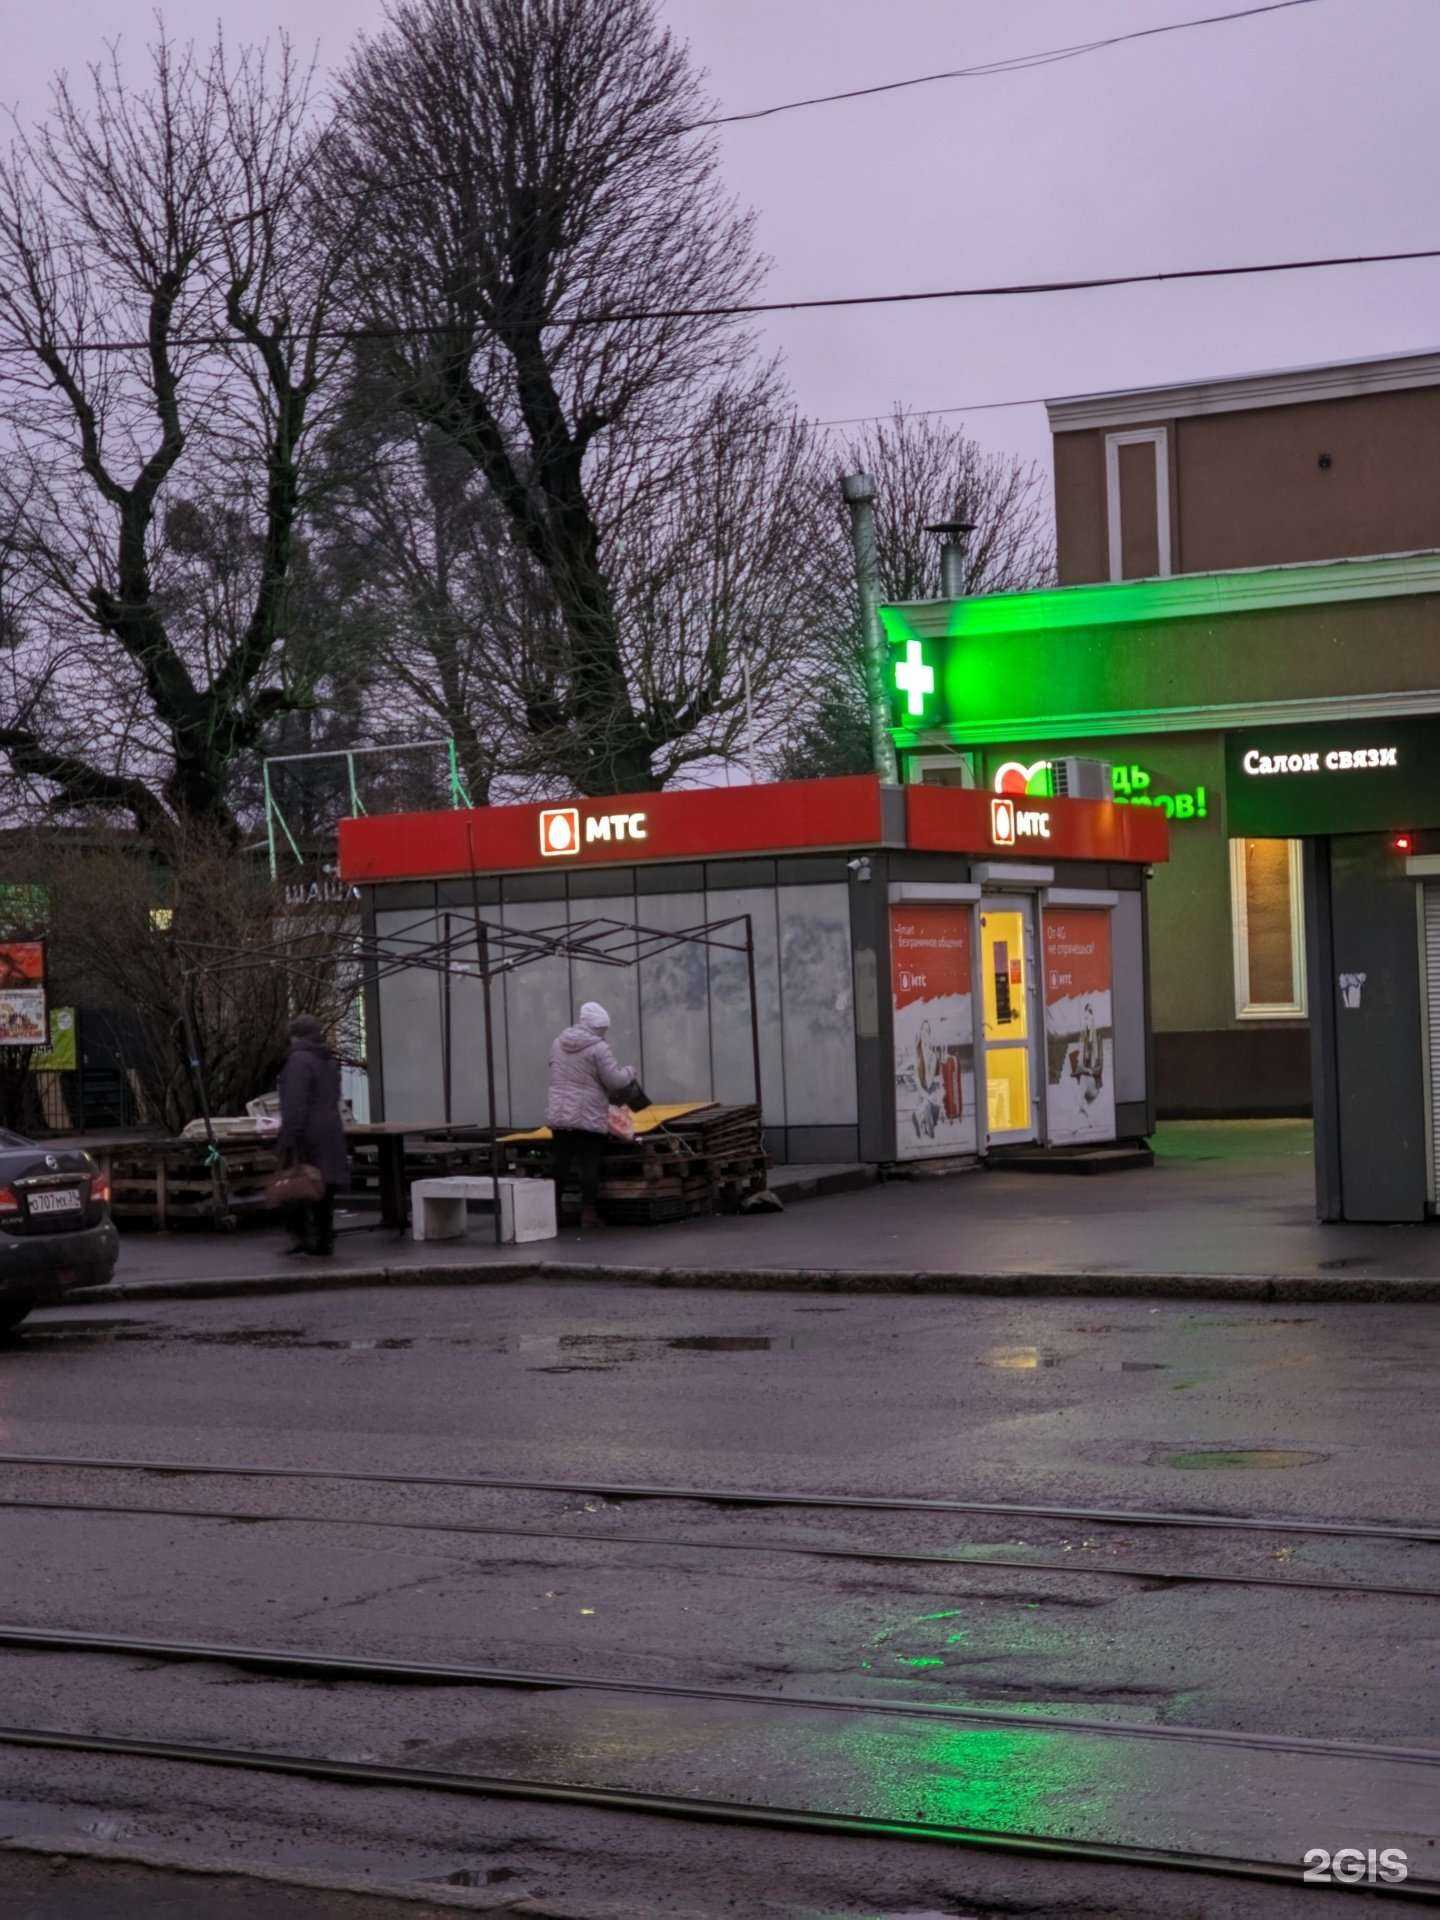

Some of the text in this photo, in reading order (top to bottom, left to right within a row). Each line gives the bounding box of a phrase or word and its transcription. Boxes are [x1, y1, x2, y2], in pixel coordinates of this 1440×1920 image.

[1243, 748, 1398, 775] Салон связи
[586, 813, 647, 842] МТС
[1017, 811, 1050, 838] МТС
